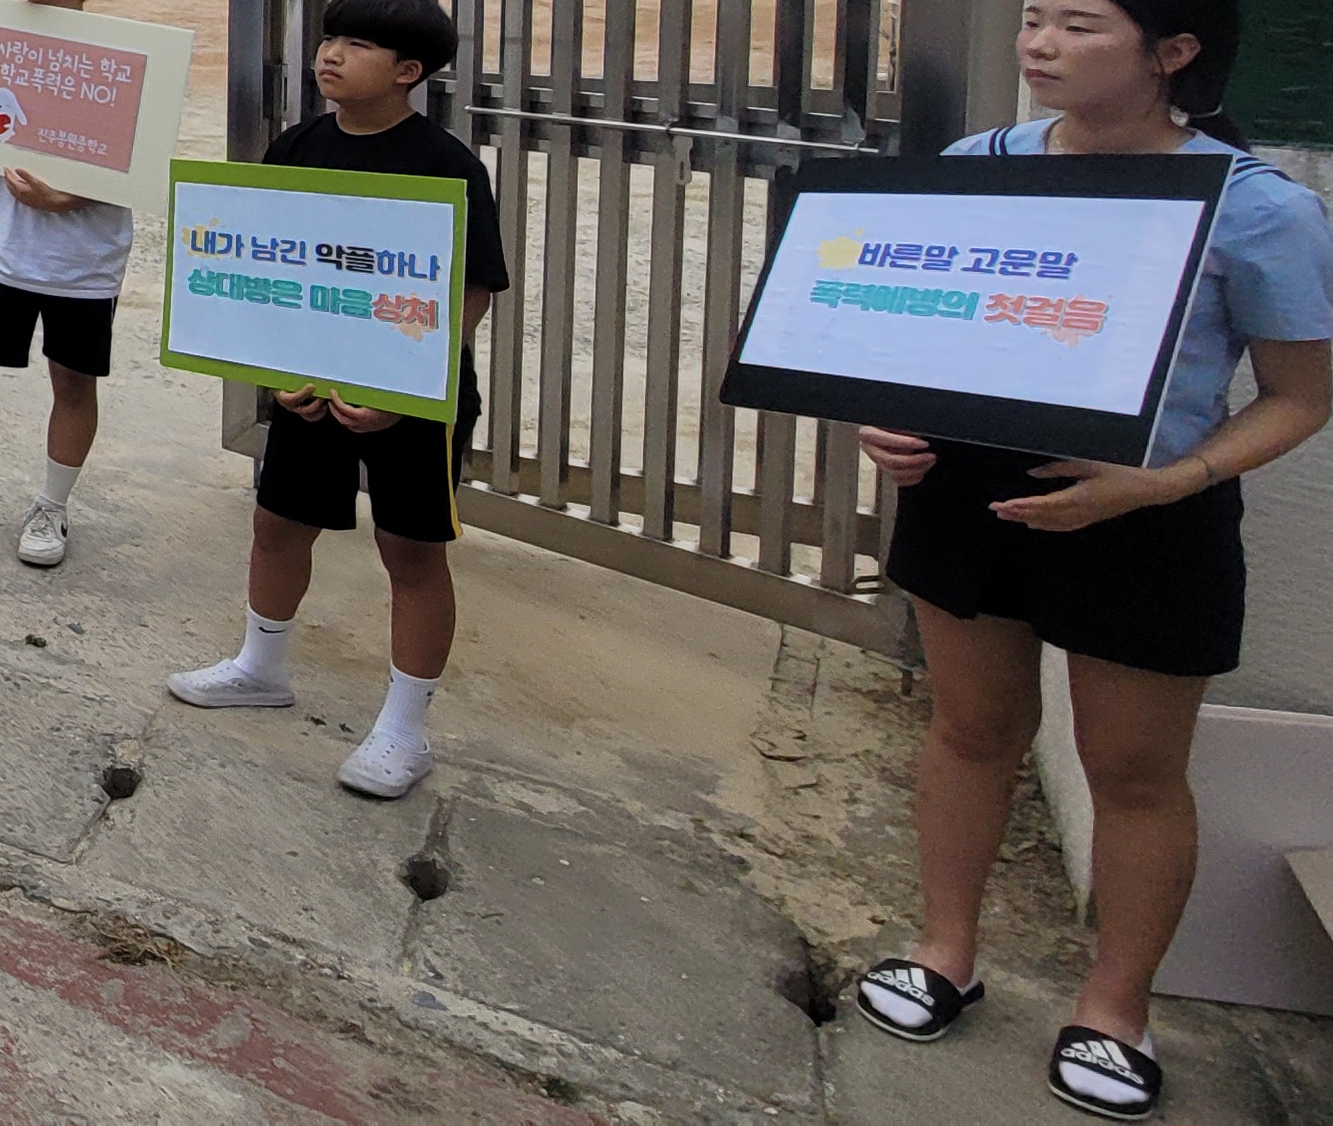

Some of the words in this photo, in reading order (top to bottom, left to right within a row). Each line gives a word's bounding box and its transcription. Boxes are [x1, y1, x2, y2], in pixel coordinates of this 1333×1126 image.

[0, 63, 76, 100] 학교폭력은
[80, 81, 118, 107] NO!
[48, 48, 94, 79] 넘치는
[100, 58, 132, 83] 학교
[190, 230, 244, 258] 내가
[250, 235, 308, 266] 남긴
[315, 243, 441, 282] 악플하나
[858, 242, 960, 272] 바른말
[960, 247, 1079, 280] 고운말
[187, 268, 304, 309] 상대방은
[810, 278, 981, 321] 폭력예방의
[983, 292, 1110, 334] 첫걸음
[866, 971, 936, 1007] adidas
[1060, 1047, 1145, 1085] adidas
